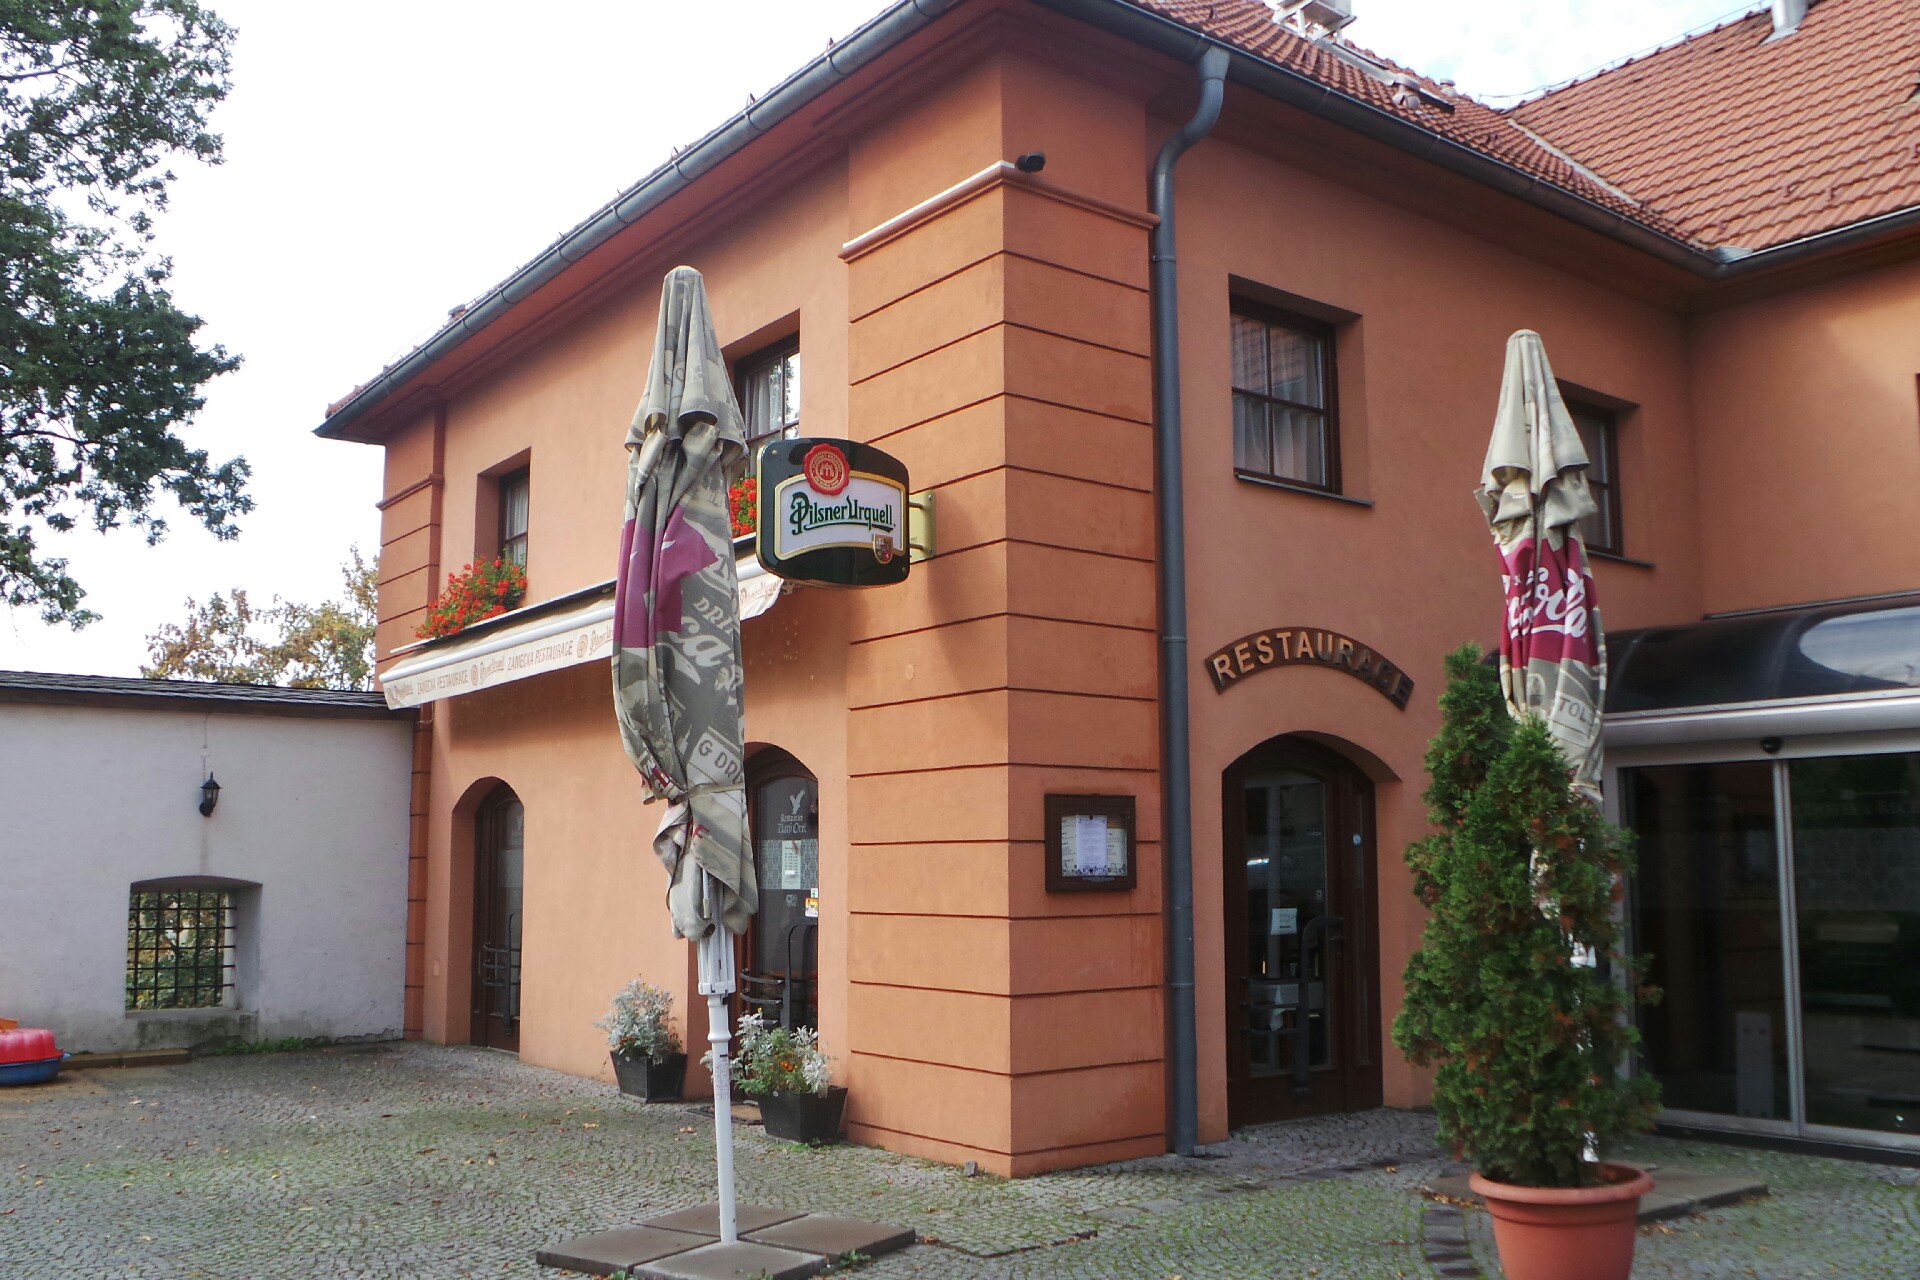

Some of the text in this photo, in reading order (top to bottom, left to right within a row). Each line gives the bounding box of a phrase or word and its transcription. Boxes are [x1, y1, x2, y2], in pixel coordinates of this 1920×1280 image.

[789, 491, 893, 536] Pilsner Urquell
[692, 596, 734, 635] DRI
[1212, 630, 1415, 704] RESTAURACE
